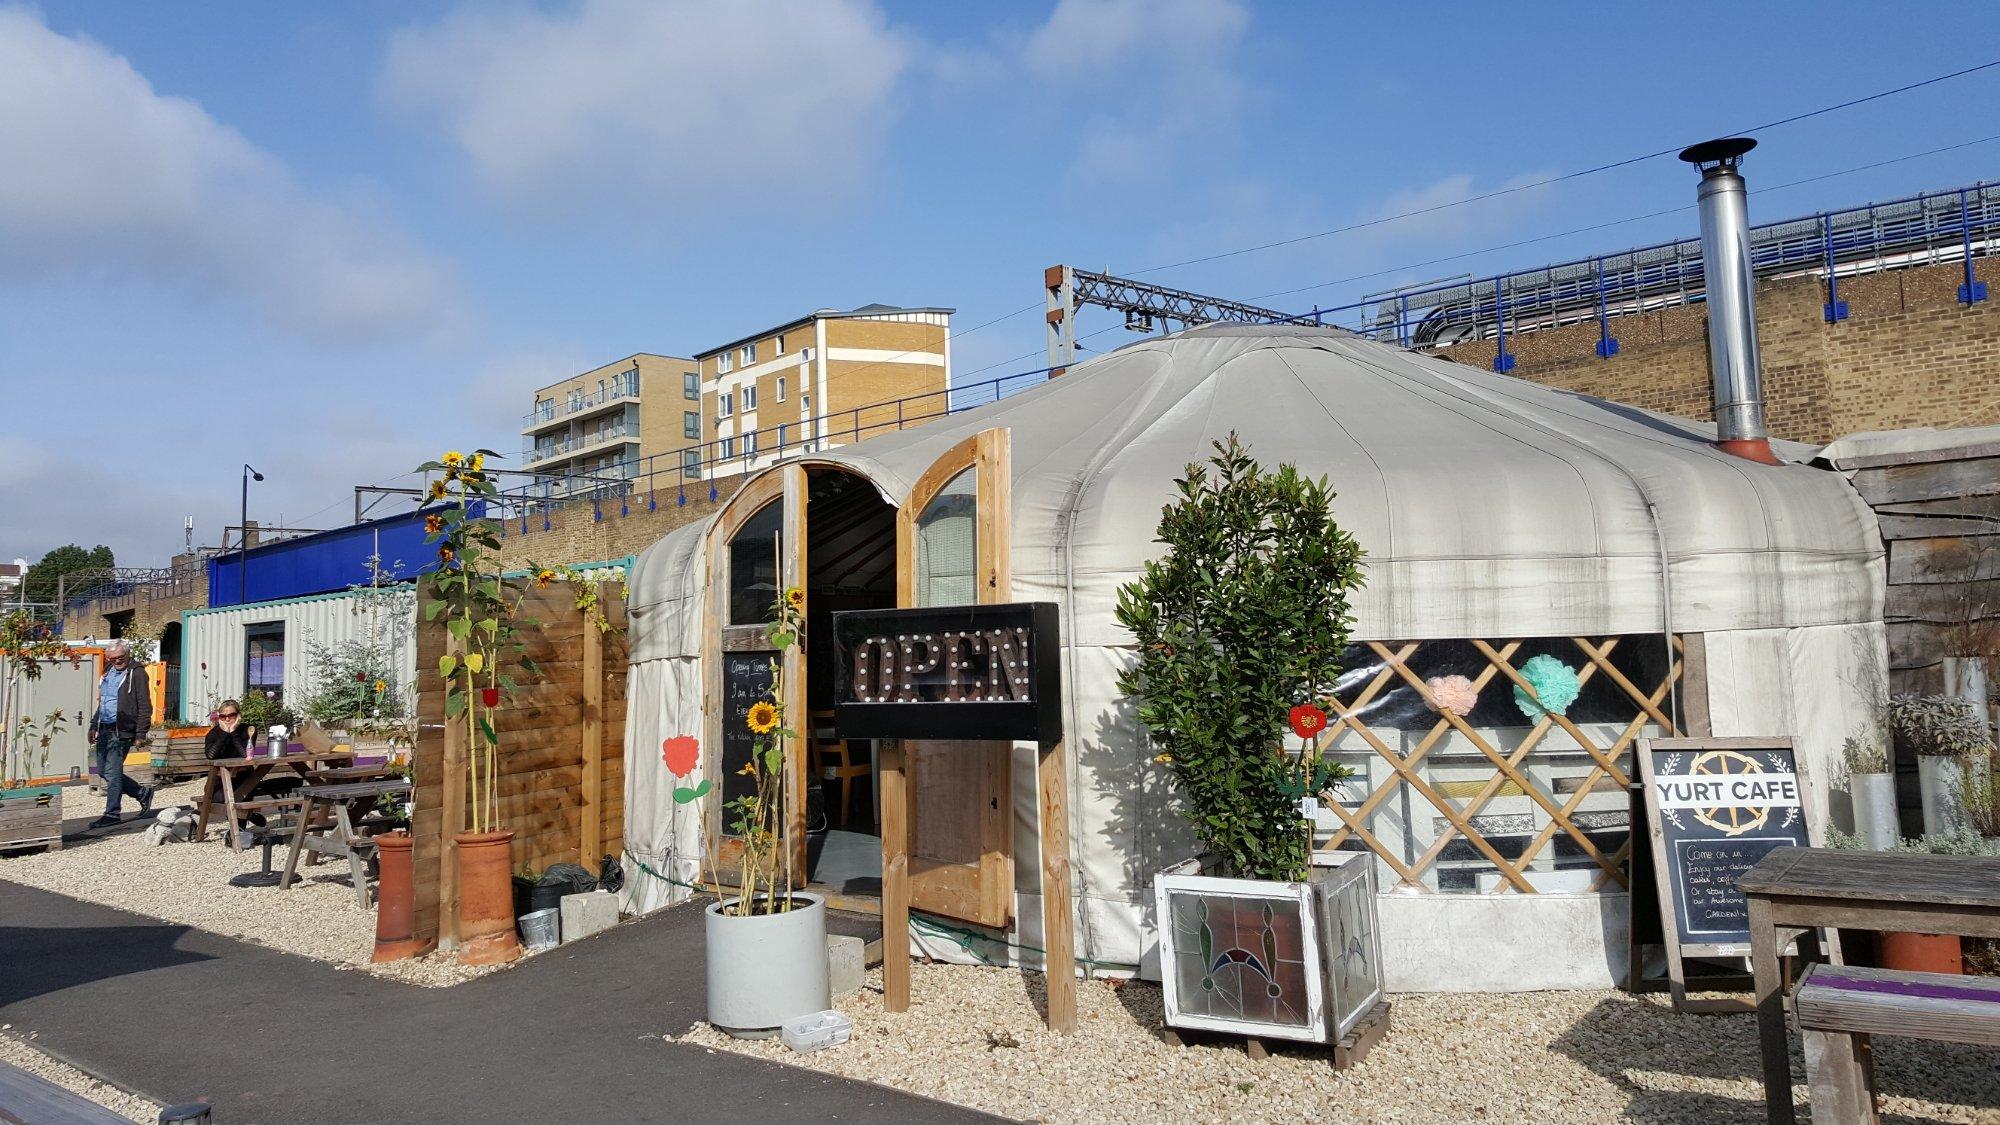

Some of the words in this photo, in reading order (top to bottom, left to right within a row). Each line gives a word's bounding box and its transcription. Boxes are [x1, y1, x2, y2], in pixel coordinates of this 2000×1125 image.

[853, 627, 1031, 704] OPEN
[1657, 782, 1724, 801] YURT
[1731, 781, 1795, 800] CAFE
[1686, 844, 1714, 861] Come
[1716, 851, 1728, 859] on
[1687, 861, 1711, 877] Enjoy
[1690, 886, 1700, 896] Or
[1705, 886, 1725, 899] stay
[1710, 897, 1744, 905] Awesome
